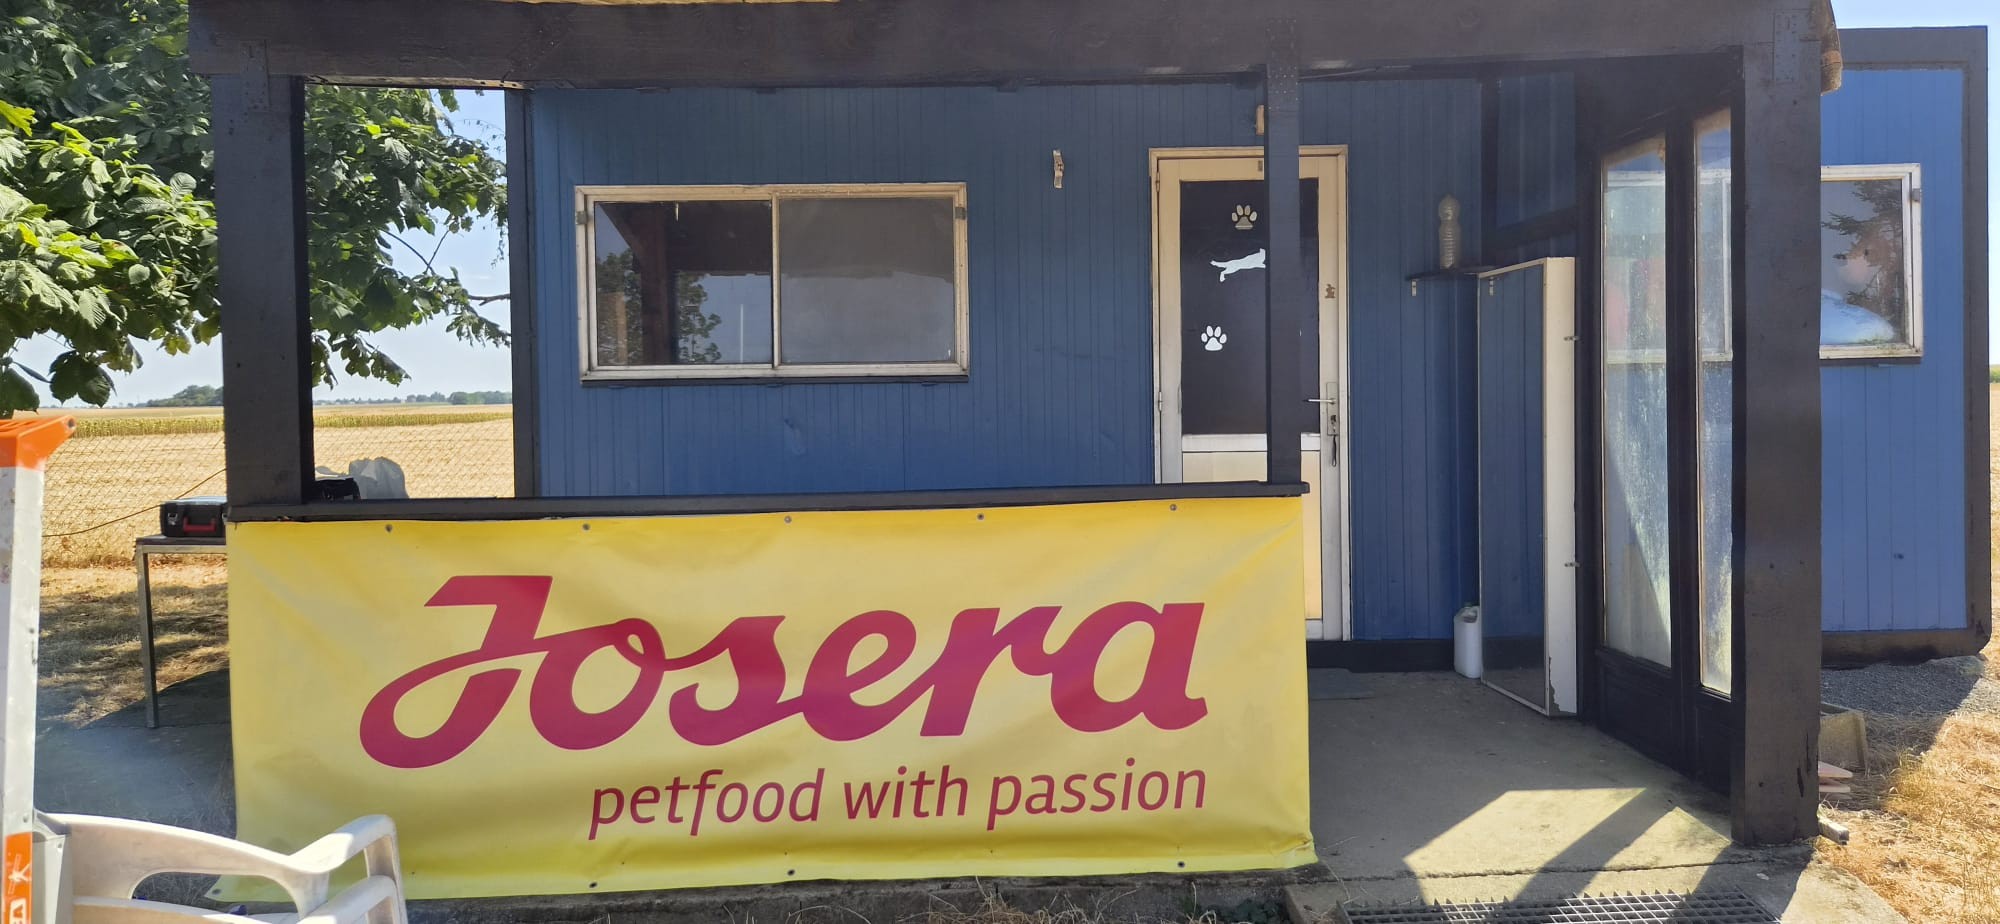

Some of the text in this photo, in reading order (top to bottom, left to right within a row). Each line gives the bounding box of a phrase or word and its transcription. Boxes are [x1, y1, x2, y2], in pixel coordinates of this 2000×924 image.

[360, 575, 1207, 768] Josera
[589, 759, 1206, 840] petfood with passion
